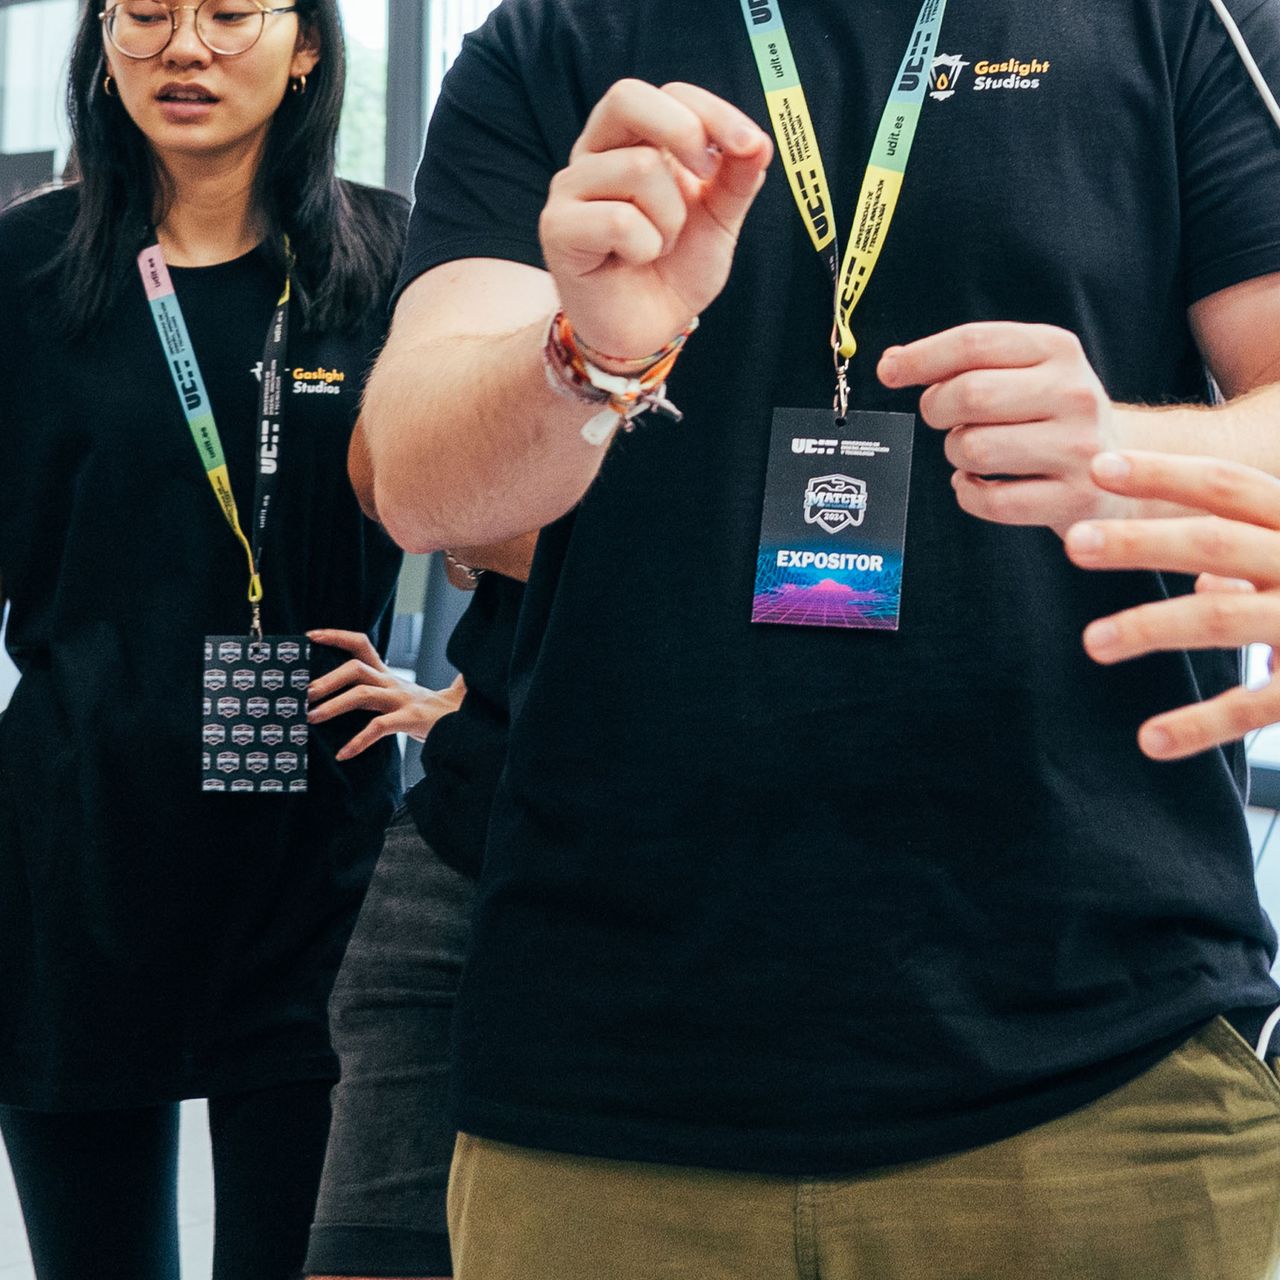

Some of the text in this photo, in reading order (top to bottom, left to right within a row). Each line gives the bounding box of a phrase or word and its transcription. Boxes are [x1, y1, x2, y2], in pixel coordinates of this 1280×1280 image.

[766, 42, 784, 78] udit.es
[974, 58, 1050, 76] Gaslight
[973, 75, 1040, 90] Studios
[886, 115, 905, 157] udit.es
[146, 257, 162, 287] udit.es
[293, 368, 344, 384] Gaslight
[293, 381, 340, 394] Studios
[199, 425, 216, 459] udit.es
[807, 491, 865, 509] MATCH
[777, 550, 884, 572] EXPOSITOR
